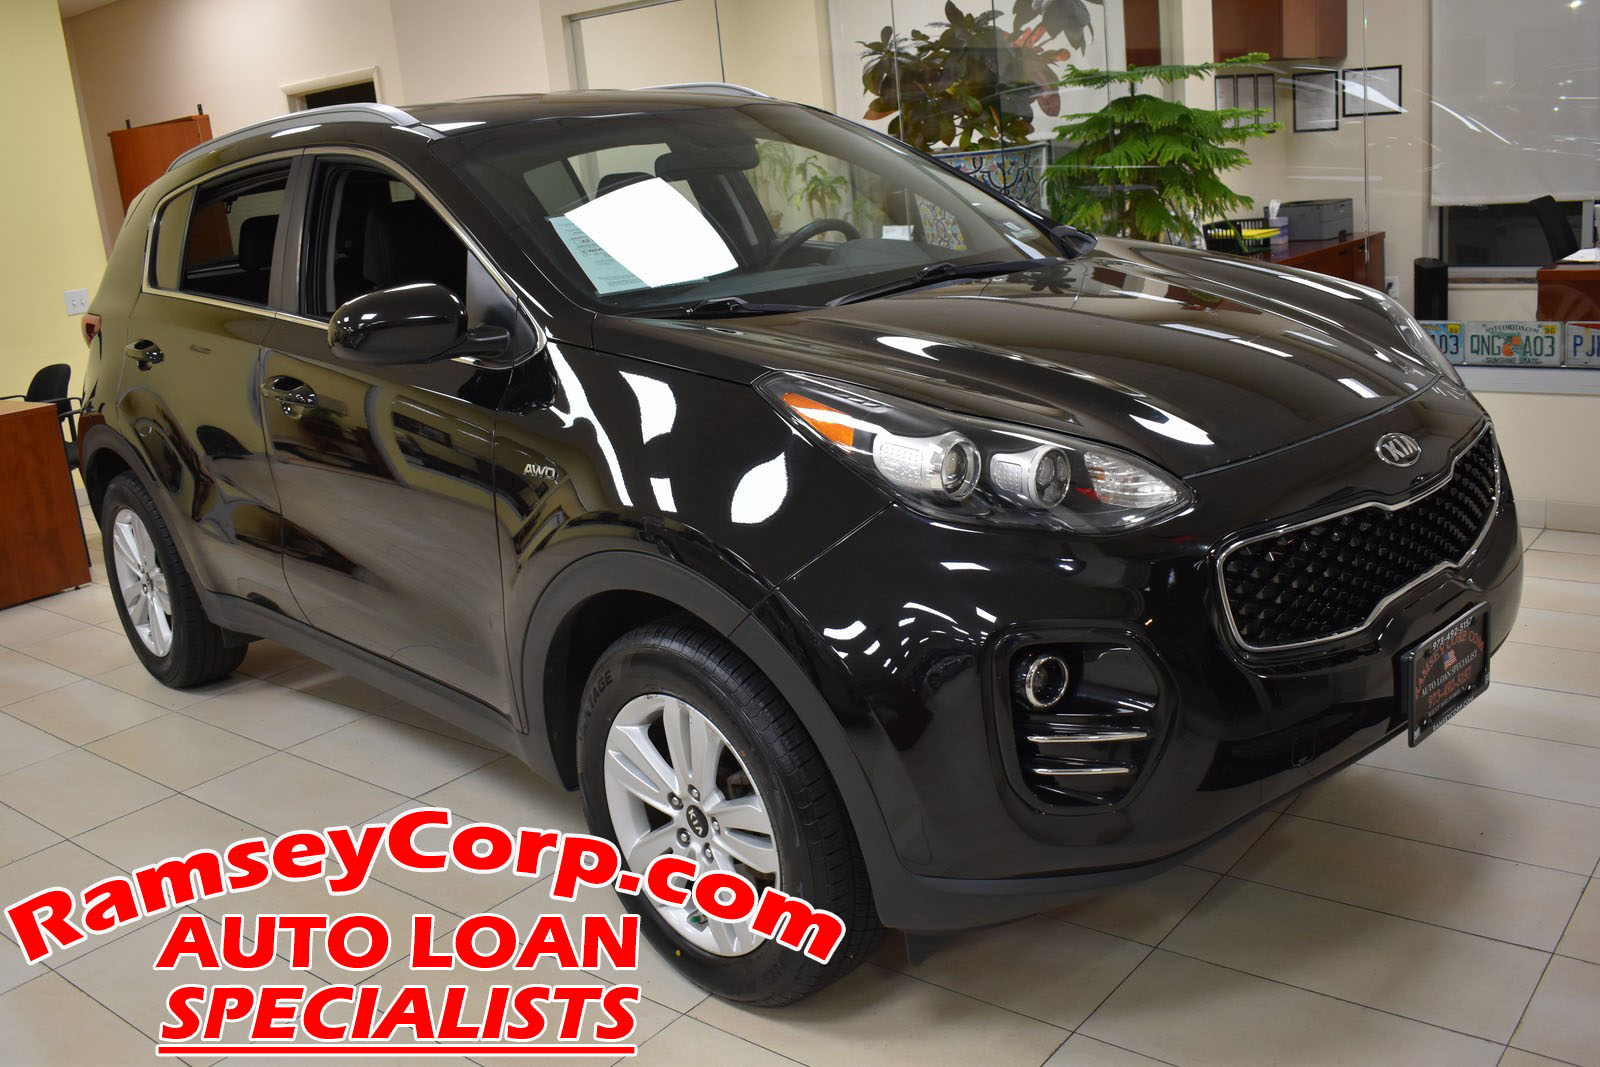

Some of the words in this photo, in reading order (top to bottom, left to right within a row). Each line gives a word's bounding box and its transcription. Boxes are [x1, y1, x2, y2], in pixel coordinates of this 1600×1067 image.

[1470, 334, 1501, 357] QNG
[1523, 335, 1555, 357] A03
[1382, 435, 1418, 462] KIA
[523, 463, 556, 481] AWD
[688, 808, 703, 836] KIA
